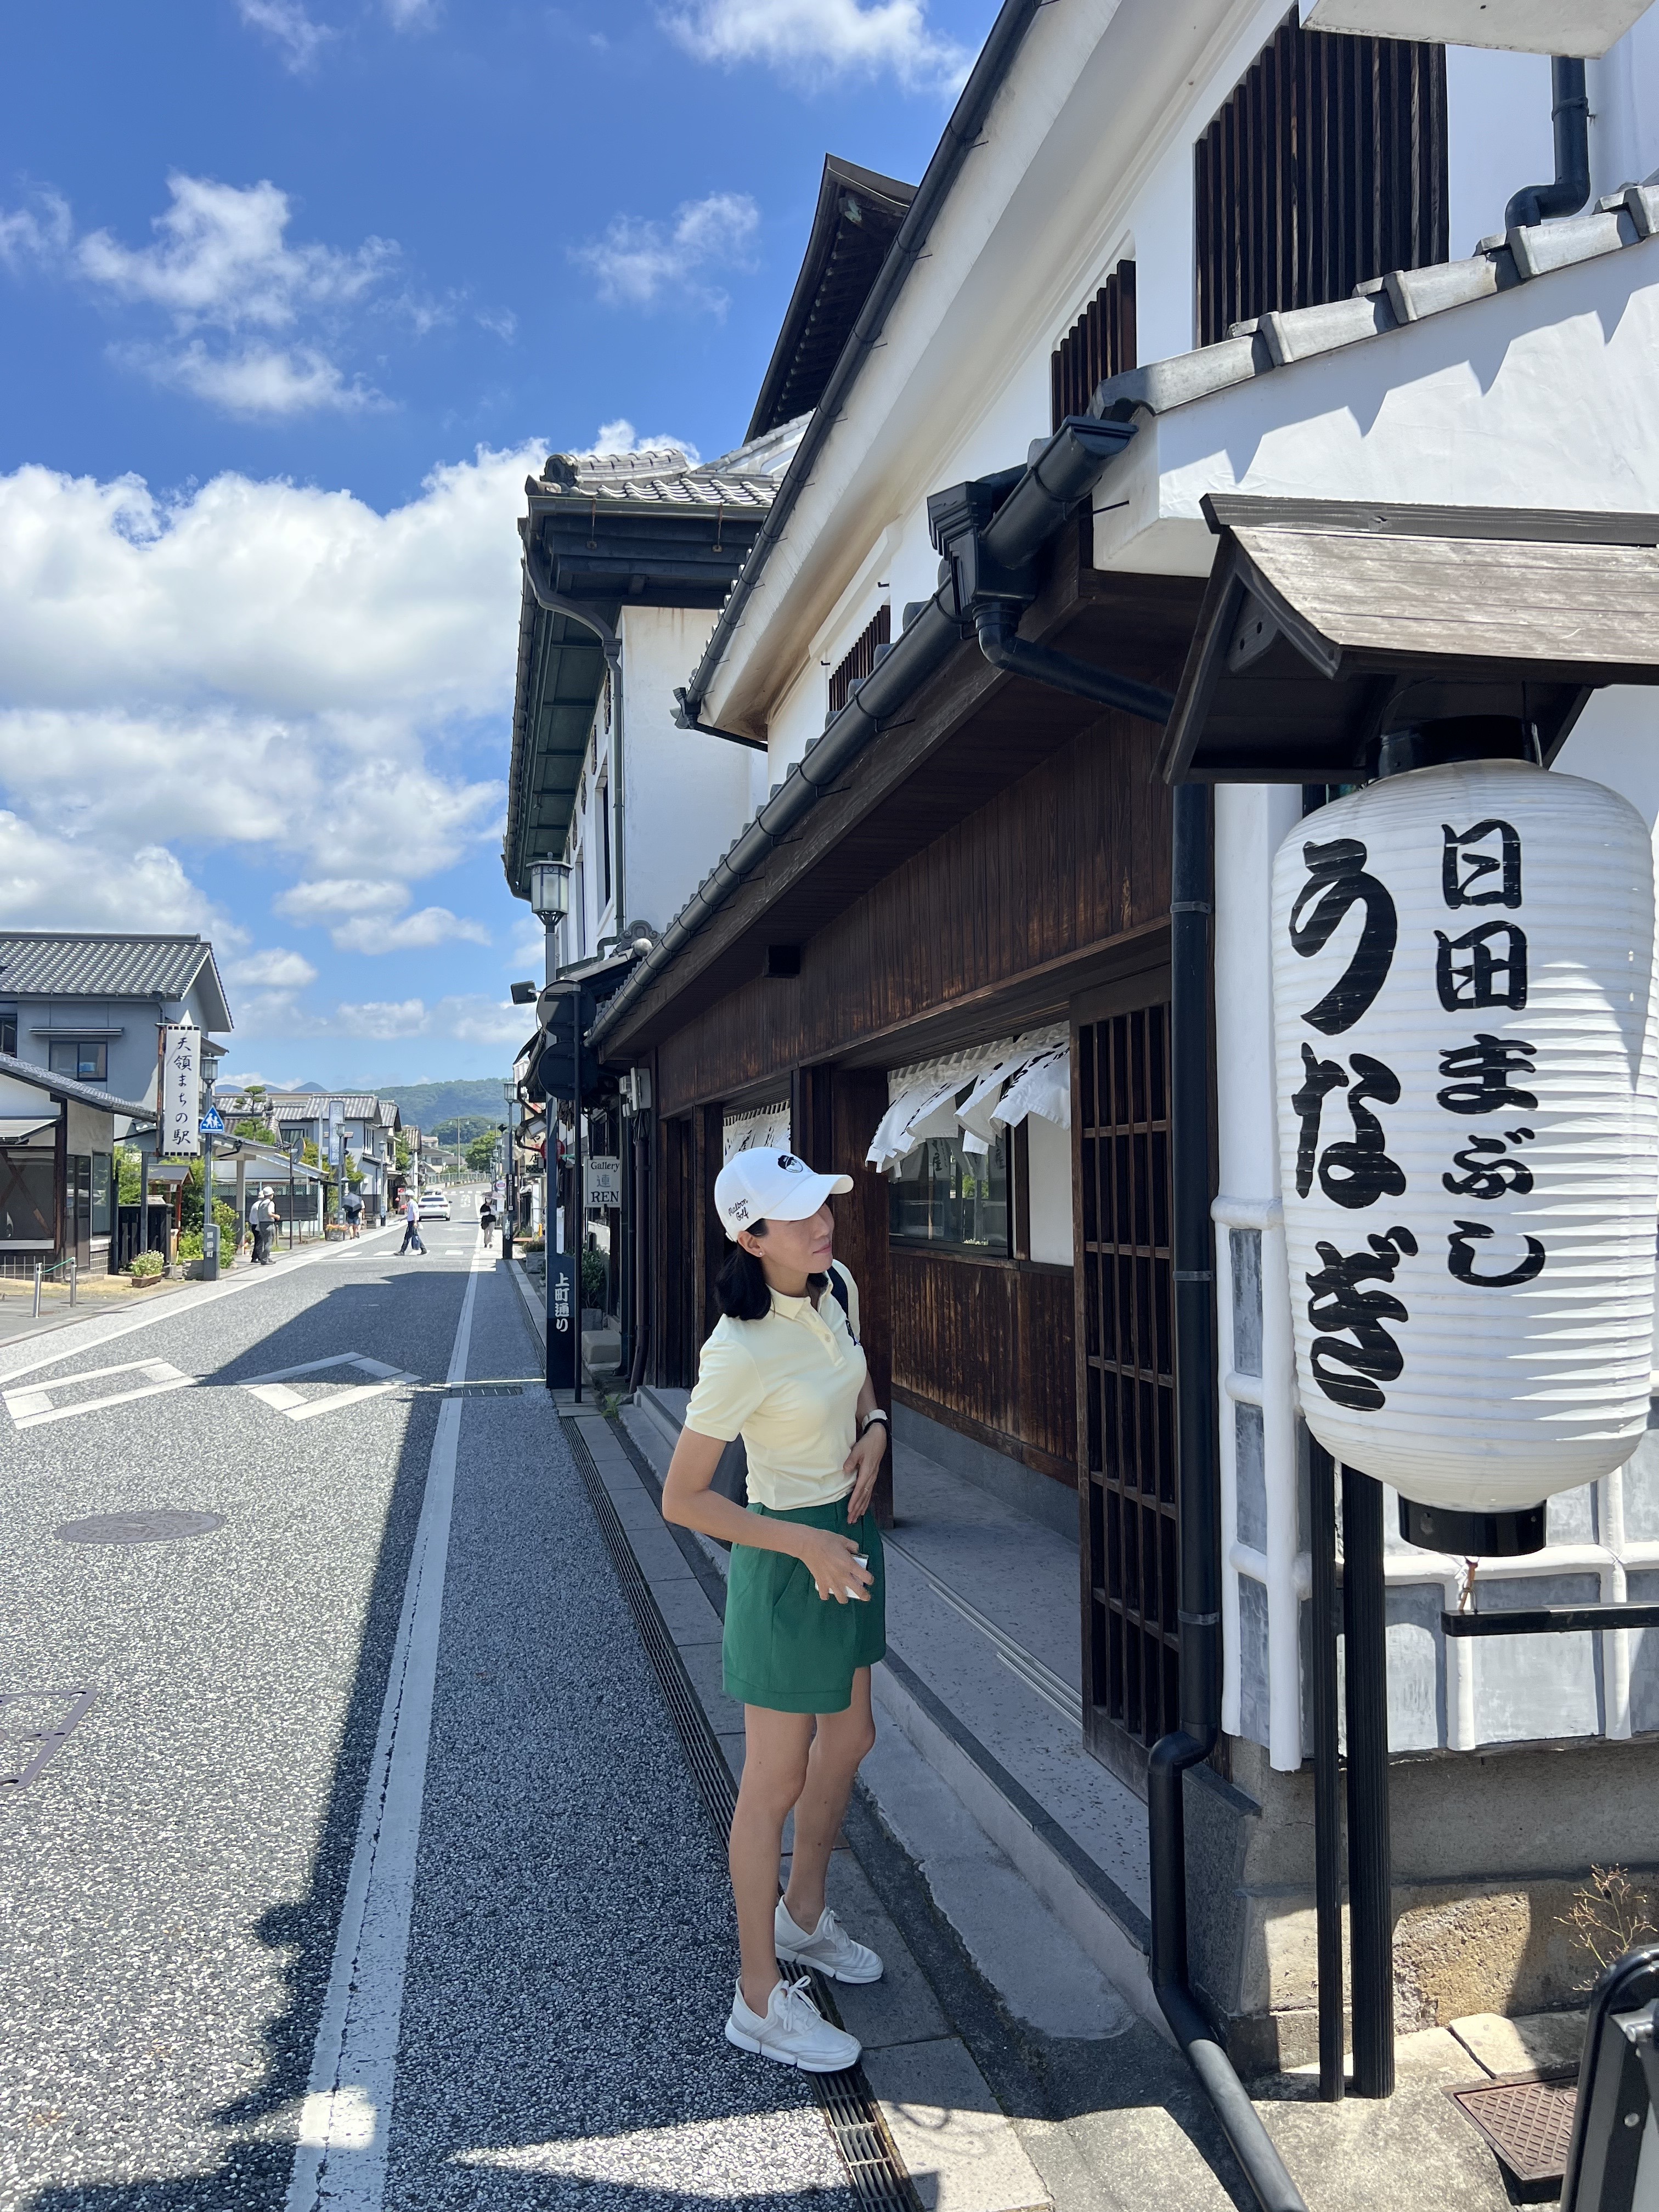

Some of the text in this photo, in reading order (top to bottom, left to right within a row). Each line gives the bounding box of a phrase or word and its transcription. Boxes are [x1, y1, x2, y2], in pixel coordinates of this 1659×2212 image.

[1434, 819, 1545, 1288] 日田まぶし
[172, 1037, 193, 1145] 天領まちの駅
[1288, 838, 1418, 1412] うなぎ
[590, 1161, 620, 1173] Gallery
[596, 1174, 611, 1188] 連
[590, 1190, 619, 1203] REN
[728, 1198, 749, 1217] Malbon
[736, 1206, 749, 1221] Golf
[555, 1272, 570, 1332] 上町通り
